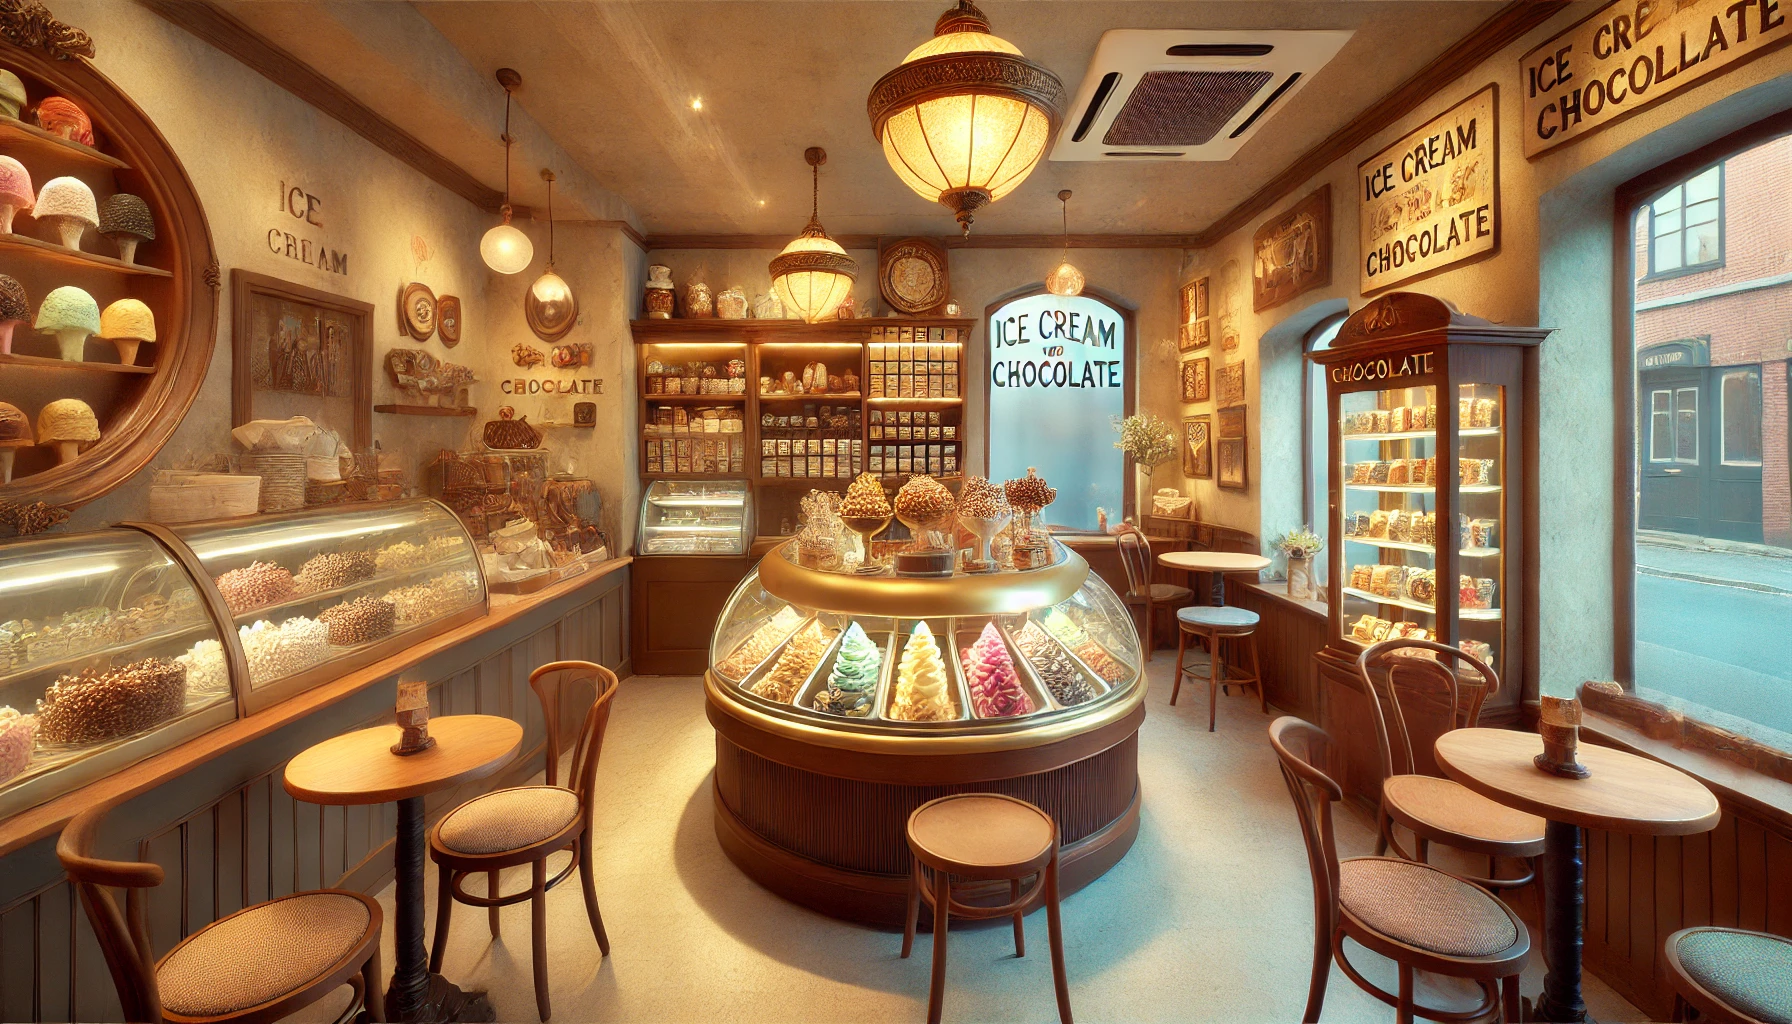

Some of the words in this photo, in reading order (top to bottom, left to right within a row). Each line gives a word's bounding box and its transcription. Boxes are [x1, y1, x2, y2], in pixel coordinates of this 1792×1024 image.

[1529, 45, 1573, 98] ICE
[1537, 0, 1785, 140] CHOCOLLATE
[1366, 162, 1395, 201] ICE
[1401, 118, 1477, 183] CREAM
[279, 180, 323, 228] ICE
[1366, 204, 1490, 277] CHOCOLATE
[996, 314, 1030, 348] ICE
[1039, 310, 1116, 349] CREAM
[992, 360, 1121, 388] CHOCOLATE
